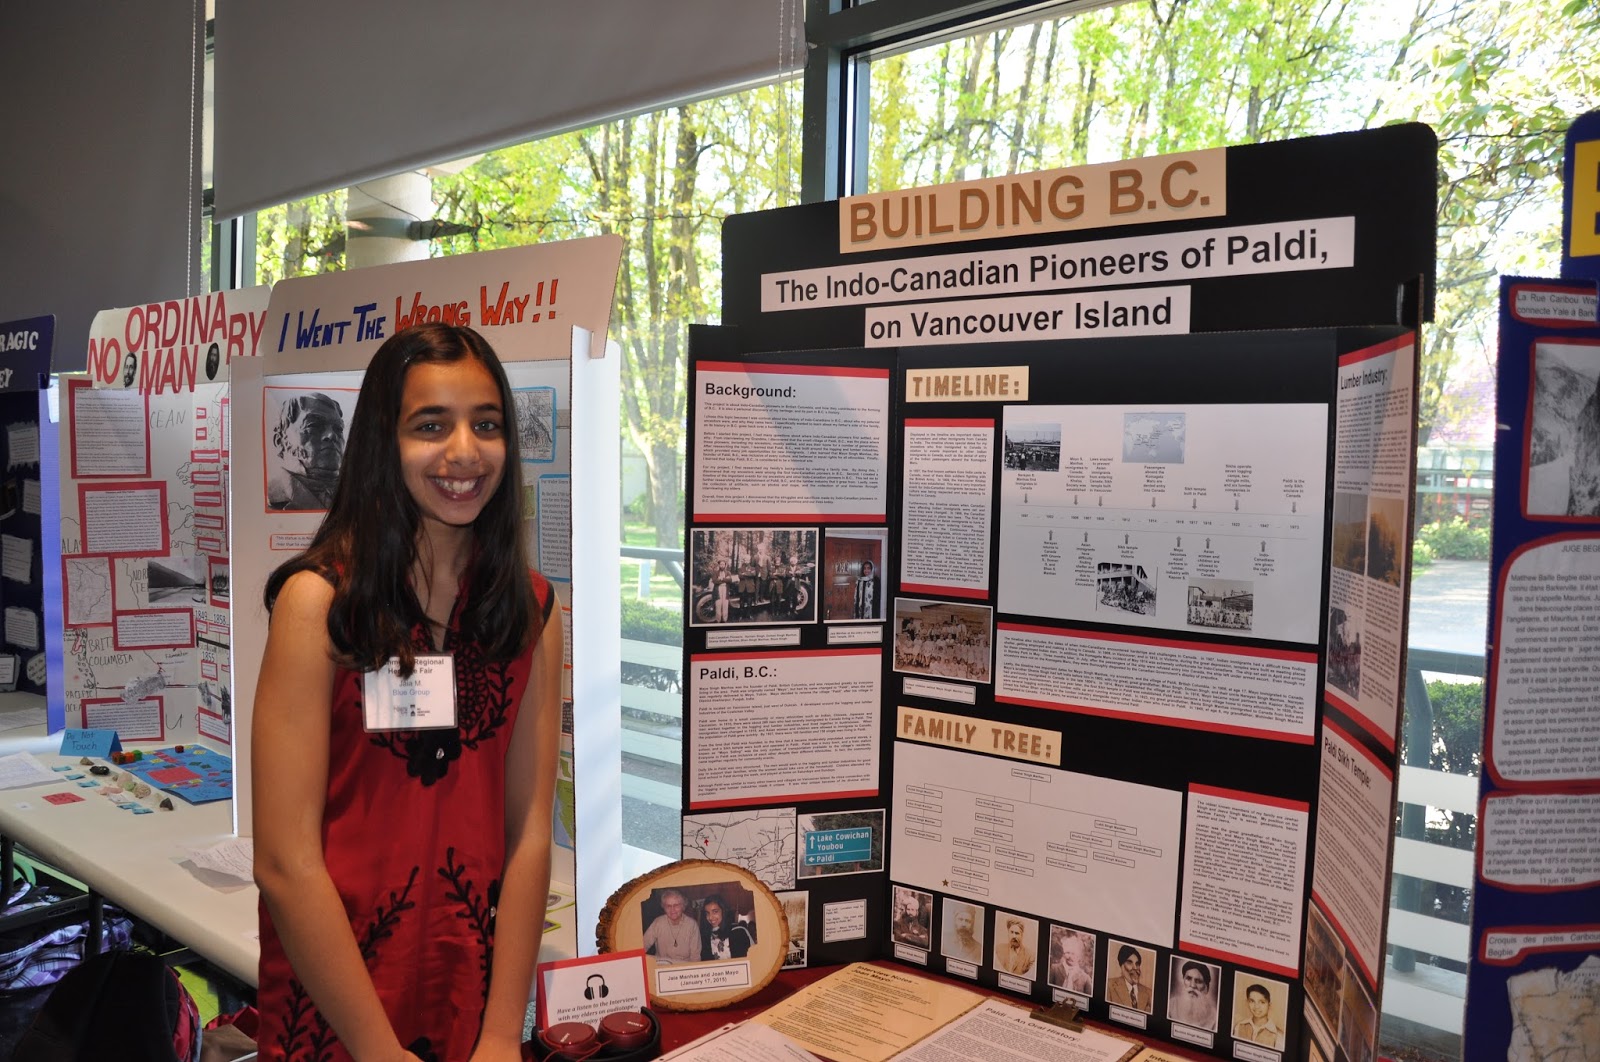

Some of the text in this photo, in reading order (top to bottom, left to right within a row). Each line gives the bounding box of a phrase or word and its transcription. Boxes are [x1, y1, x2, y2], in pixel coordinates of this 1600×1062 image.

[849, 160, 1211, 243] BUILDING B.C.
[776, 229, 1329, 304] The Indo-Canadian Pioneers of Paldi,
[1530, 294, 1546, 302] Rue
[1550, 294, 1578, 304] Caribou
[870, 296, 1172, 339] on Vancouver Island
[1517, 307, 1550, 315] connecte
[1552, 308, 1568, 316] Yale
[278, 313, 290, 353] I
[296, 308, 351, 349] WENT
[354, 303, 387, 343] THE
[395, 291, 471, 333] WRONG
[87, 291, 267, 385] NO ORDINARY
[139, 344, 199, 396] MAN
[912, 374, 1020, 397] TIMELINE:
[1340, 368, 1388, 390] Lumber Industry:
[705, 382, 796, 399] Background:
[1562, 544, 1580, 552] JUGE
[89, 654, 134, 667] COLUMBIA
[414, 658, 444, 666] Regional
[700, 666, 777, 680] Paldi, B.C.:
[66, 690, 93, 700] PACIFIC
[81, 730, 96, 738] Not
[903, 714, 1052, 757] FAMILY TREE:
[71, 740, 98, 751] Touch
[1324, 736, 1372, 789] Paldi Sikh Temple:
[817, 831, 870, 842] Lake Cowichan
[817, 842, 844, 851] Youbou
[816, 854, 834, 862] Paldi
[1488, 936, 1517, 944] Croquis
[1543, 936, 1564, 944] pistes
[1488, 948, 1514, 957] Begbie
[857, 966, 912, 984] Interview Notes
[577, 1004, 592, 1012] listen
[610, 996, 638, 1006] Interviews
[581, 1009, 598, 1018] elders
[985, 1007, 1006, 1018] Paldi
[1028, 1021, 1046, 1032] Oral
